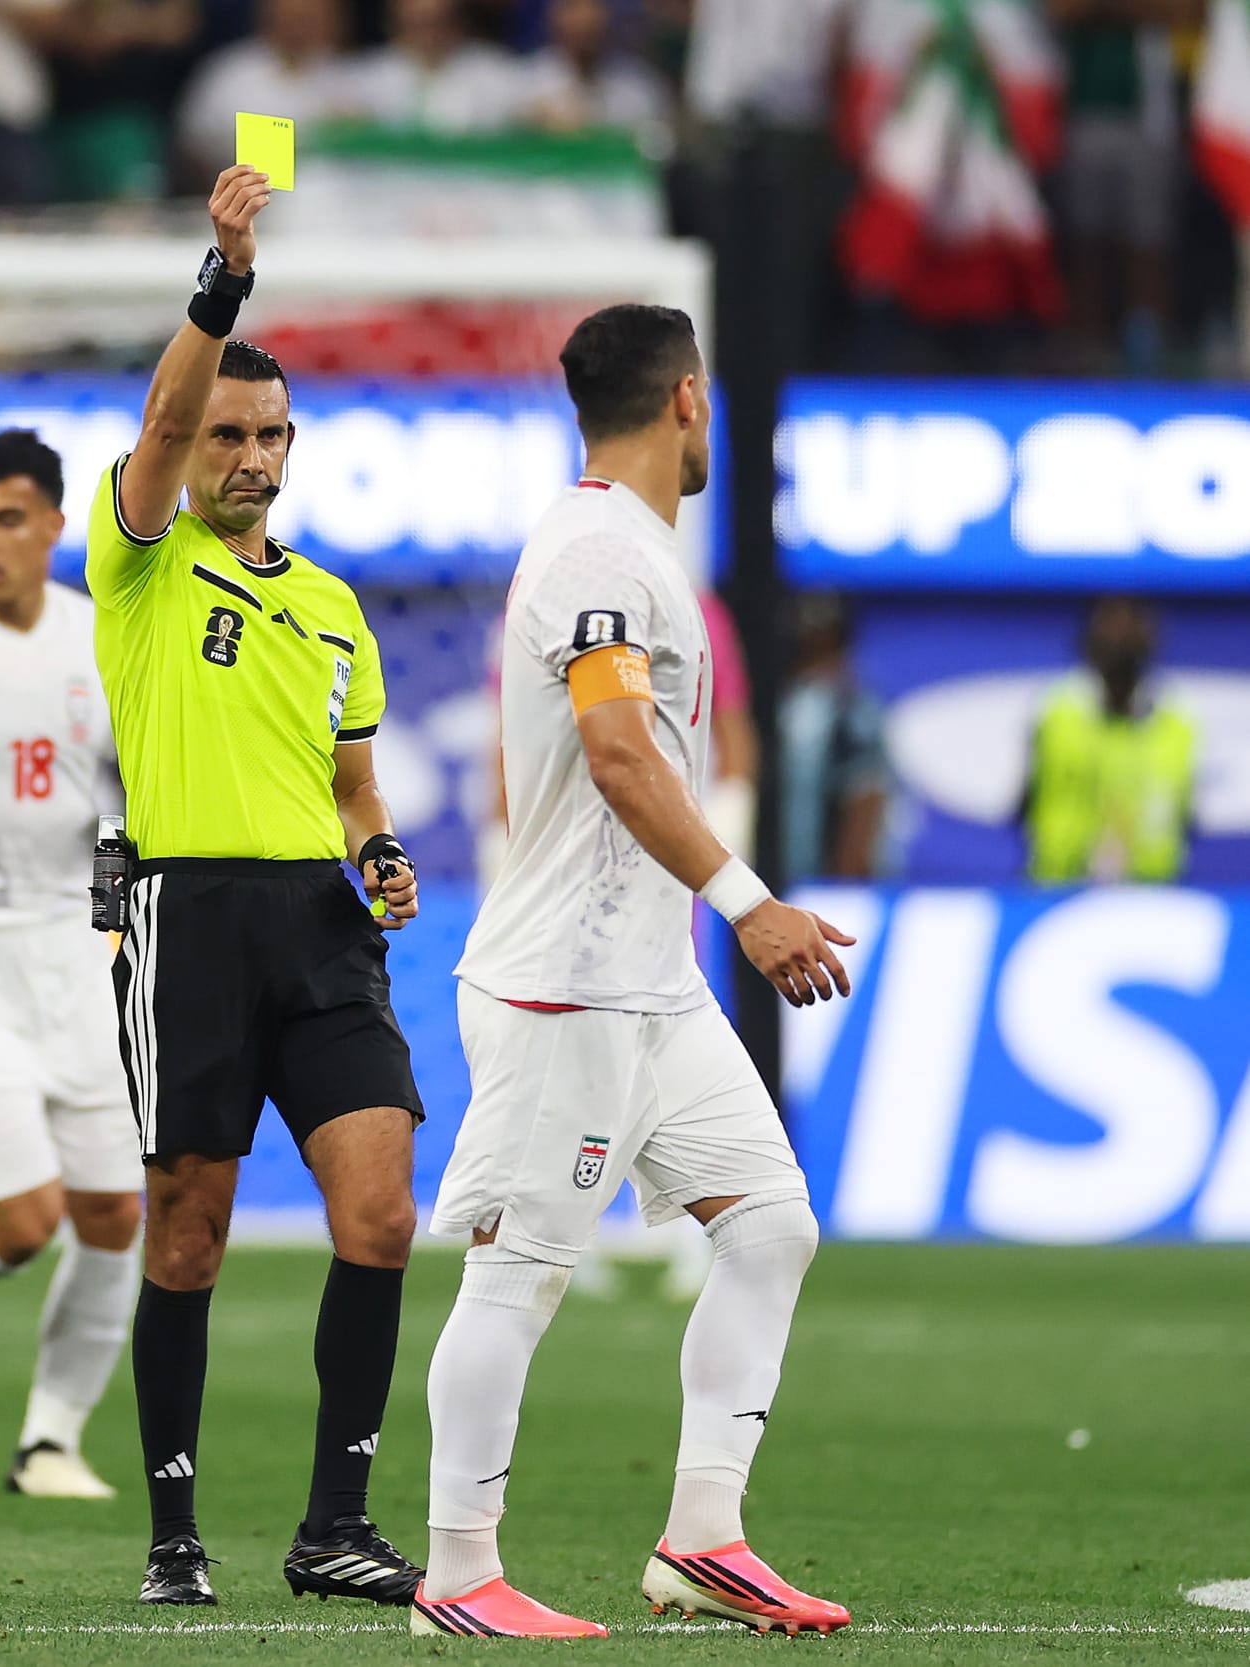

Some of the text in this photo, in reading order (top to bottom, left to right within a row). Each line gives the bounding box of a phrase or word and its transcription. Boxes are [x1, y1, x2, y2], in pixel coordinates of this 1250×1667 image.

[273, 121, 290, 129] FIFA
[210, 651, 228, 663] FIFA
[336, 661, 350, 686] FIF
[11, 736, 58, 803] 18
